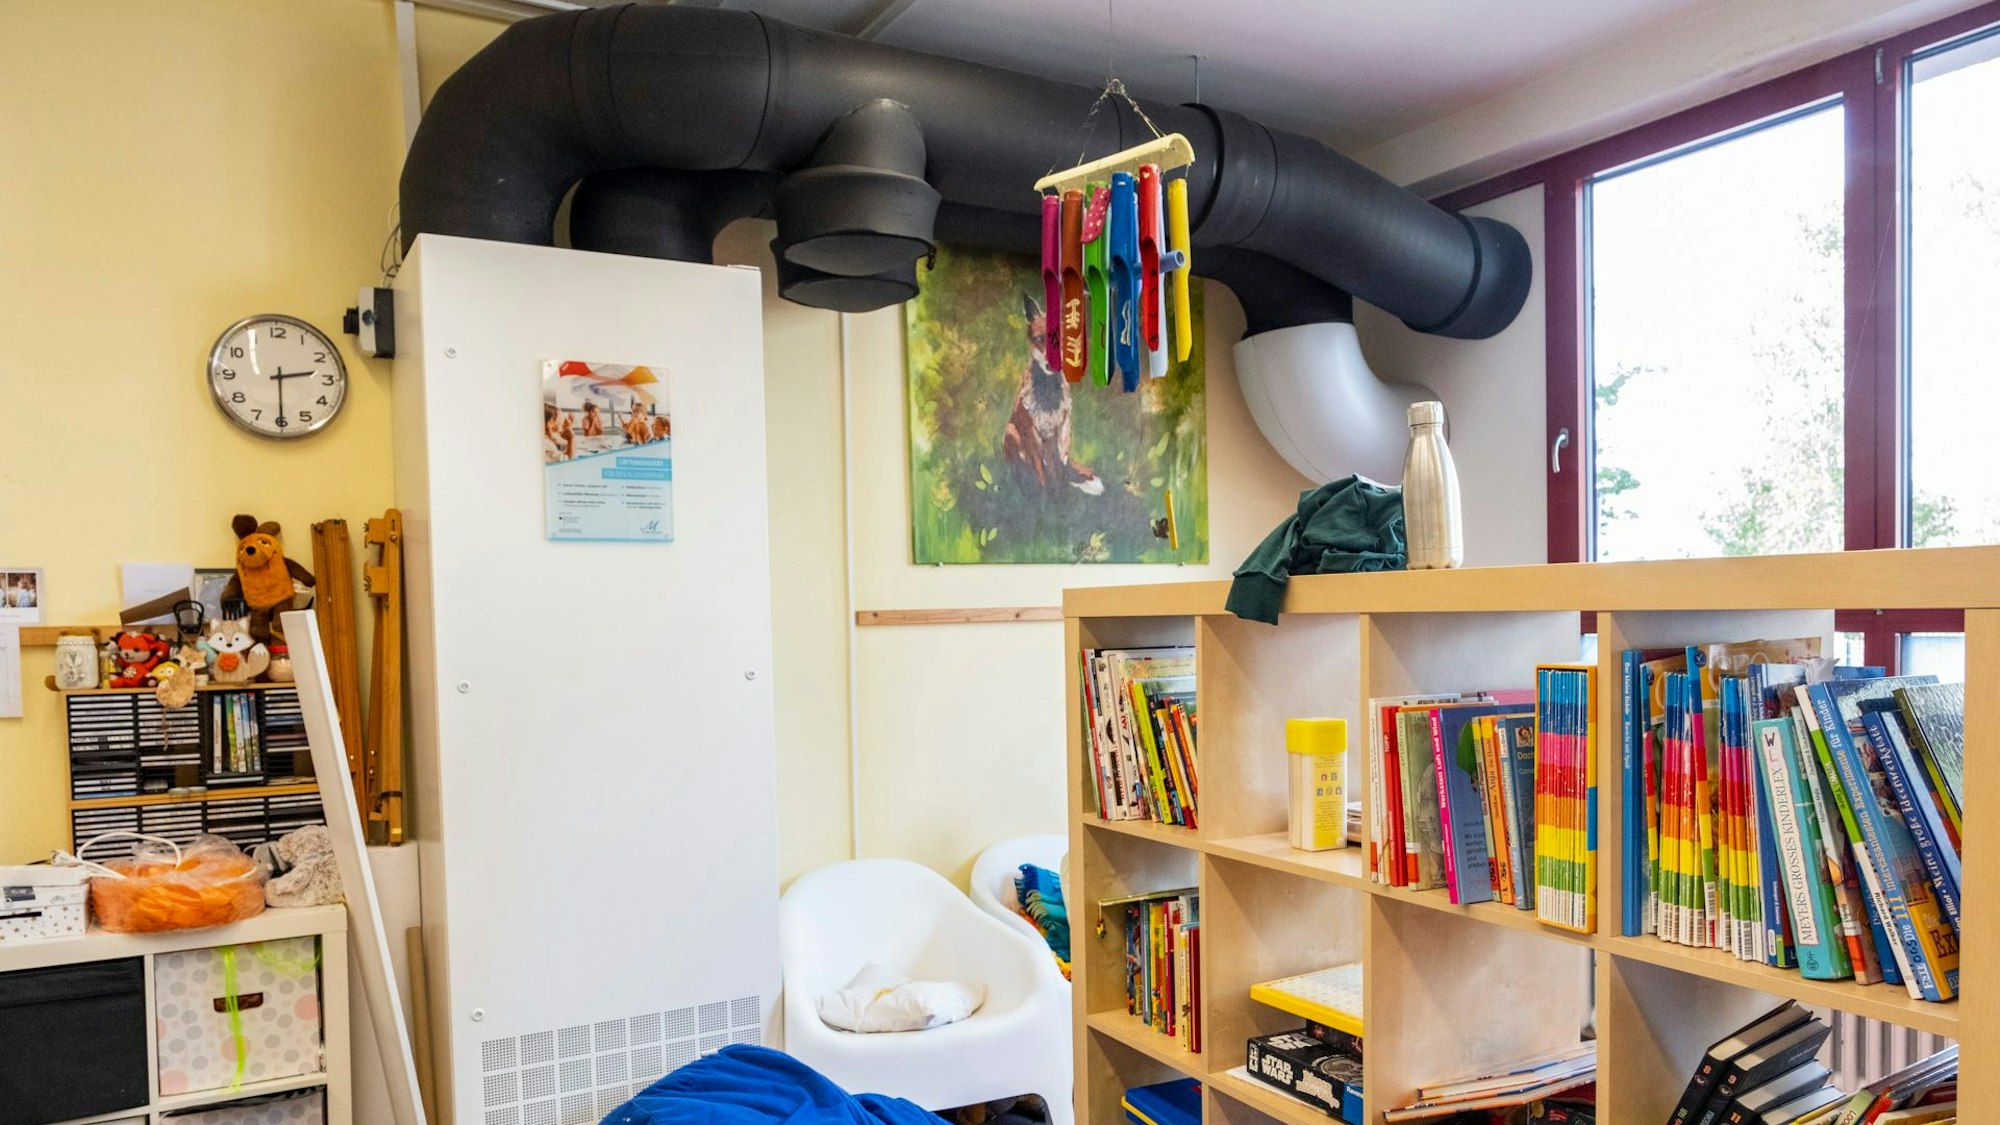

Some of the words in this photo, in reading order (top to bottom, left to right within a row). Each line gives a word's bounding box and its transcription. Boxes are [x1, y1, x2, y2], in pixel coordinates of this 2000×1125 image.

[270, 327, 287, 339] 12
[230, 347, 244, 358] 10
[314, 352, 326, 363] 2
[222, 369, 236, 380] 9
[322, 375, 334, 386] 3
[232, 392, 246, 403] 8
[316, 395, 328, 406] 4
[251, 409, 262, 421] 7
[275, 416, 288, 428] 6
[300, 411, 312, 422] 5
[1814, 697, 1836, 732] Kinder
[1430, 716, 1439, 735] Wind
[1432, 736, 1440, 751] und
[1827, 731, 1842, 749] für
[1434, 753, 1443, 769] Luft
[1833, 748, 1867, 810] Experimente
[1436, 770, 1447, 808] Werkstatt
[1770, 767, 1795, 835] KINDERLEX
[1906, 814, 1932, 850] große
[1856, 810, 1898, 892] interessantesten
[1783, 836, 1805, 890] GROSSES
[1921, 849, 1947, 889] Meine
[1793, 891, 1814, 941] MEYERS
[1888, 894, 1908, 922] 111
[1873, 891, 1889, 920] Richard
[1884, 920, 1899, 947] Walker
[1261, 1058, 1293, 1085] WARS
[1265, 1054, 1291, 1073] STAR
[1703, 1064, 1712, 1075] 8
[1728, 1074, 1737, 1084] 9
[1730, 1112, 1742, 1124] 11
